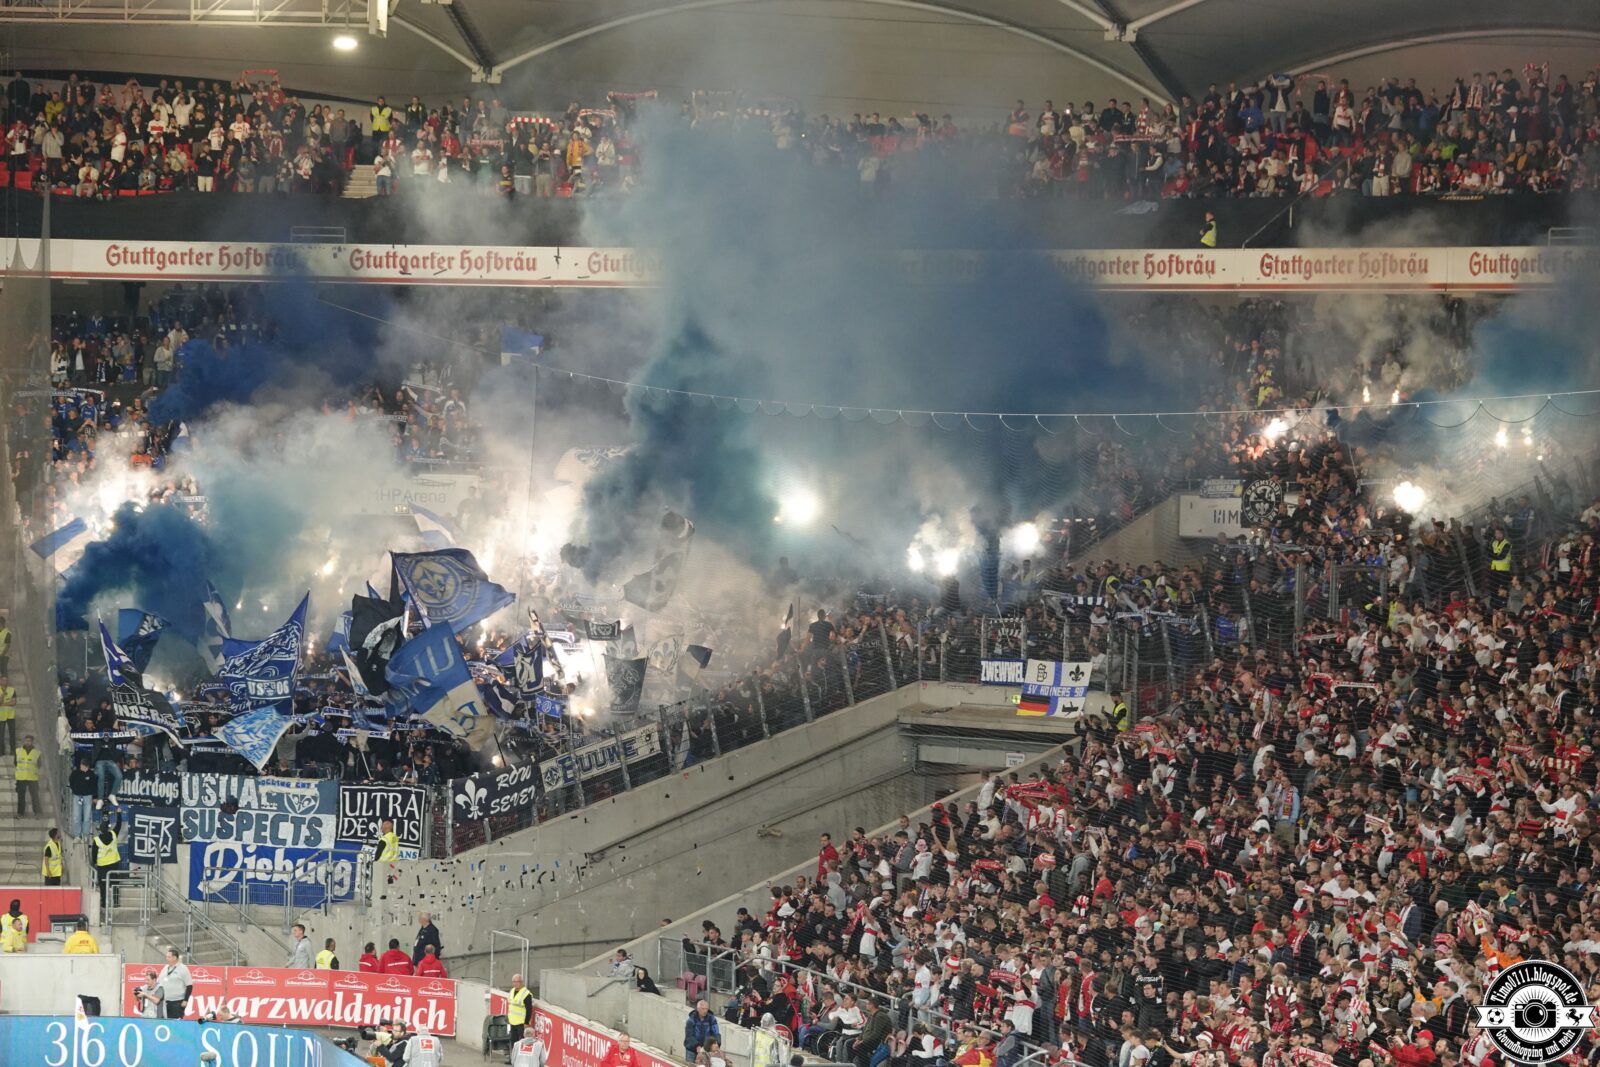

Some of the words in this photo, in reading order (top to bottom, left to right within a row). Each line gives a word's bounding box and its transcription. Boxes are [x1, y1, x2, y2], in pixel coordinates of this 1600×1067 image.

[106, 244, 214, 270] Stuttgarter
[218, 245, 297, 271] Hofbräu
[349, 248, 455, 272] Stuttgarter
[459, 249, 537, 274] Hofbräu
[588, 252, 664, 277] Stuttgar
[1055, 255, 1140, 280] tuttgarter
[1144, 253, 1216, 279] Hofbräu
[1260, 253, 1354, 280] Stuttgarter
[1359, 252, 1429, 279] Hofbräu
[981, 661, 1024, 682] ZWEWWEL
[1027, 685, 1037, 694] SV
[119, 770, 179, 805] nderdogs
[182, 809, 323, 848] SUSPECTS
[399, 850, 418, 860] ANS
[197, 842, 352, 897] Dieburg
[133, 991, 448, 1031] warzwaldmilch
